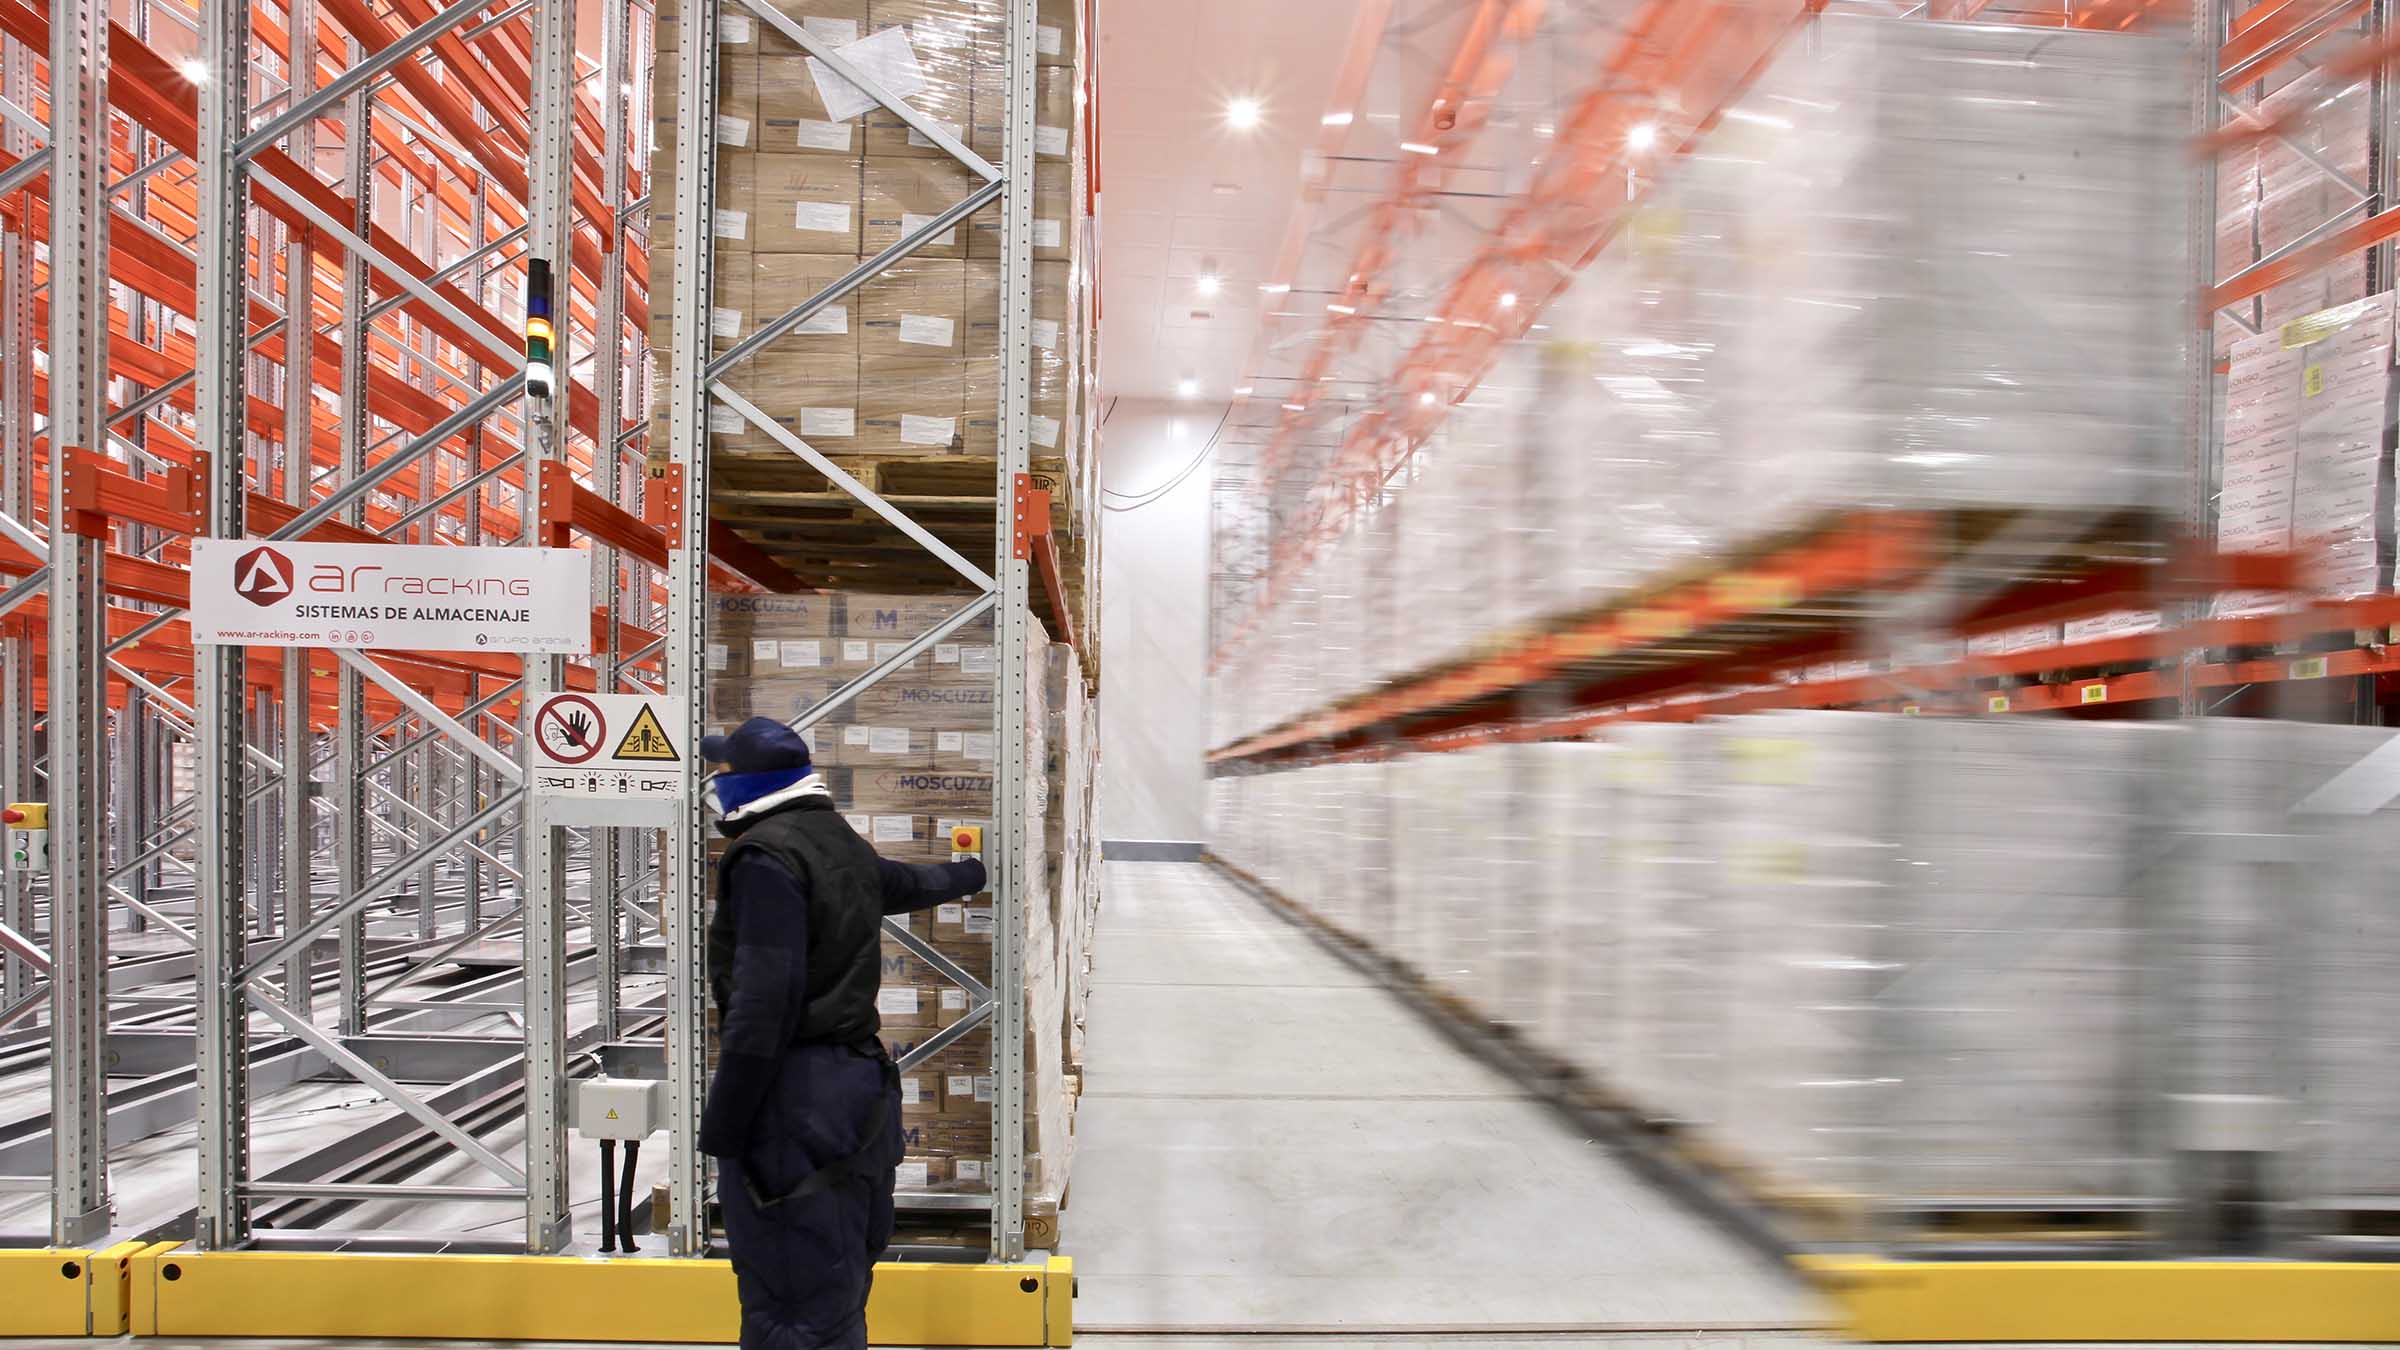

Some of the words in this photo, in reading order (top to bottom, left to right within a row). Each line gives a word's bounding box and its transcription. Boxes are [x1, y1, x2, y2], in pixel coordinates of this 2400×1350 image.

[296, 604, 378, 620] SISTEMAS
[385, 607, 407, 620] DE
[413, 608, 530, 622] ALMACENAJE
[217, 629, 320, 641] www.ar-racking.com
[902, 687, 993, 704] MOSCUZZ
